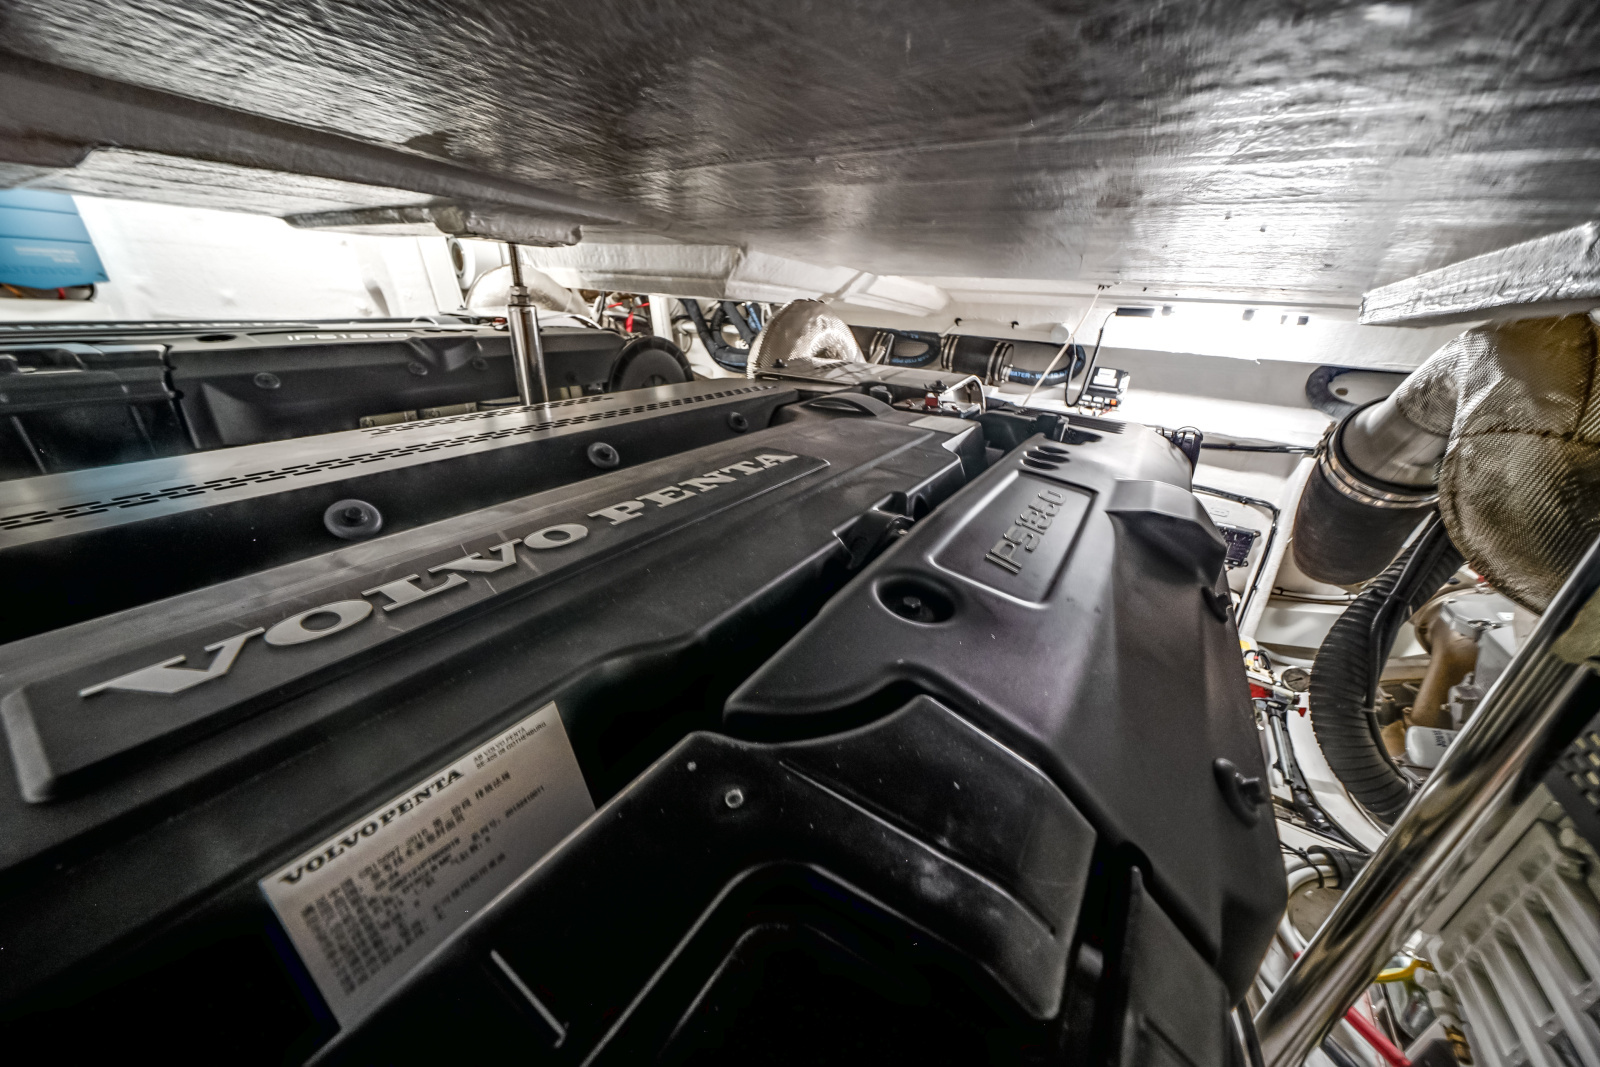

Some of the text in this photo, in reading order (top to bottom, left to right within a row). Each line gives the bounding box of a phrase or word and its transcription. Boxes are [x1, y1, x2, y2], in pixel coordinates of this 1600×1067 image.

[80, 452, 800, 698] VOLVO PENTA
[506, 726, 527, 742] PENTA
[279, 821, 379, 885] VOLVO
[378, 768, 465, 828] PENTA
